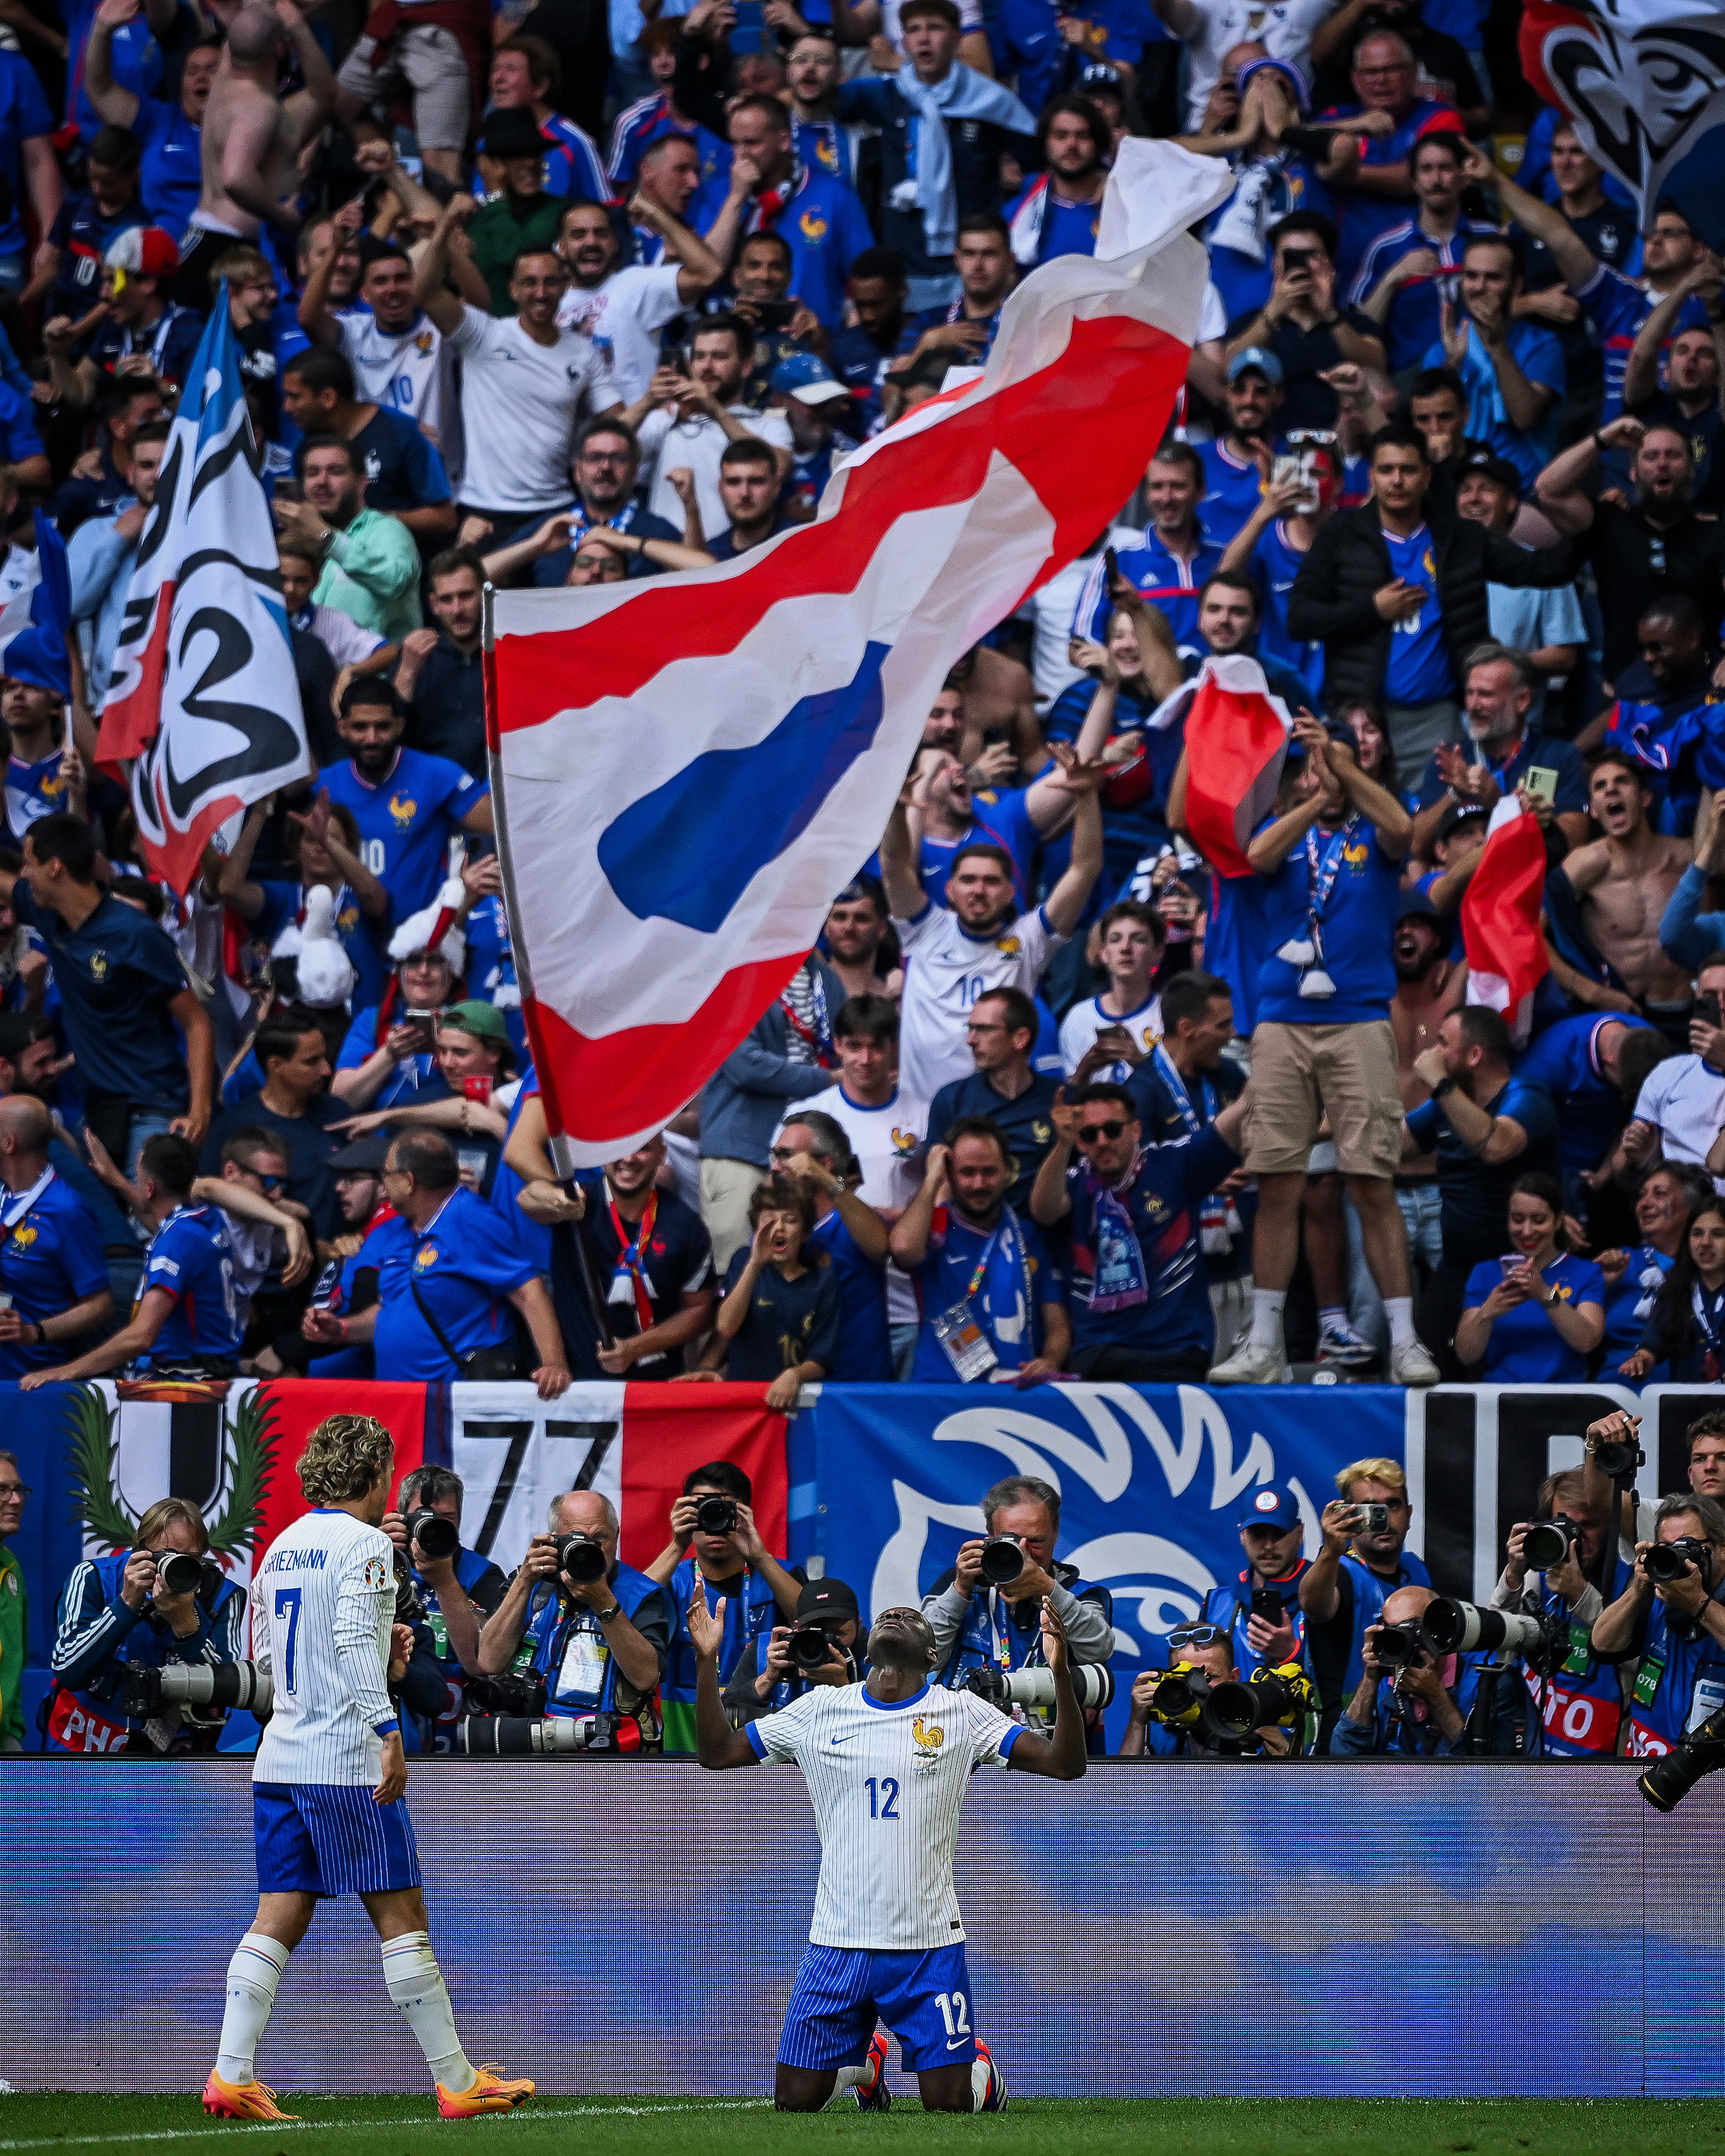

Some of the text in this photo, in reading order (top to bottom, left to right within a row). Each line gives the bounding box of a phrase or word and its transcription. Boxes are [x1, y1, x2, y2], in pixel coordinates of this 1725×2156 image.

[389, 375, 414, 409] 10
[360, 839, 386, 876] 10
[959, 975, 984, 1007] 10
[264, 1548, 329, 1574] GRIEZMANN
[275, 1587, 302, 1695] 7
[1637, 1673, 1657, 1691] 078
[864, 1777, 900, 1820] 12
[934, 1991, 971, 2035] 12
